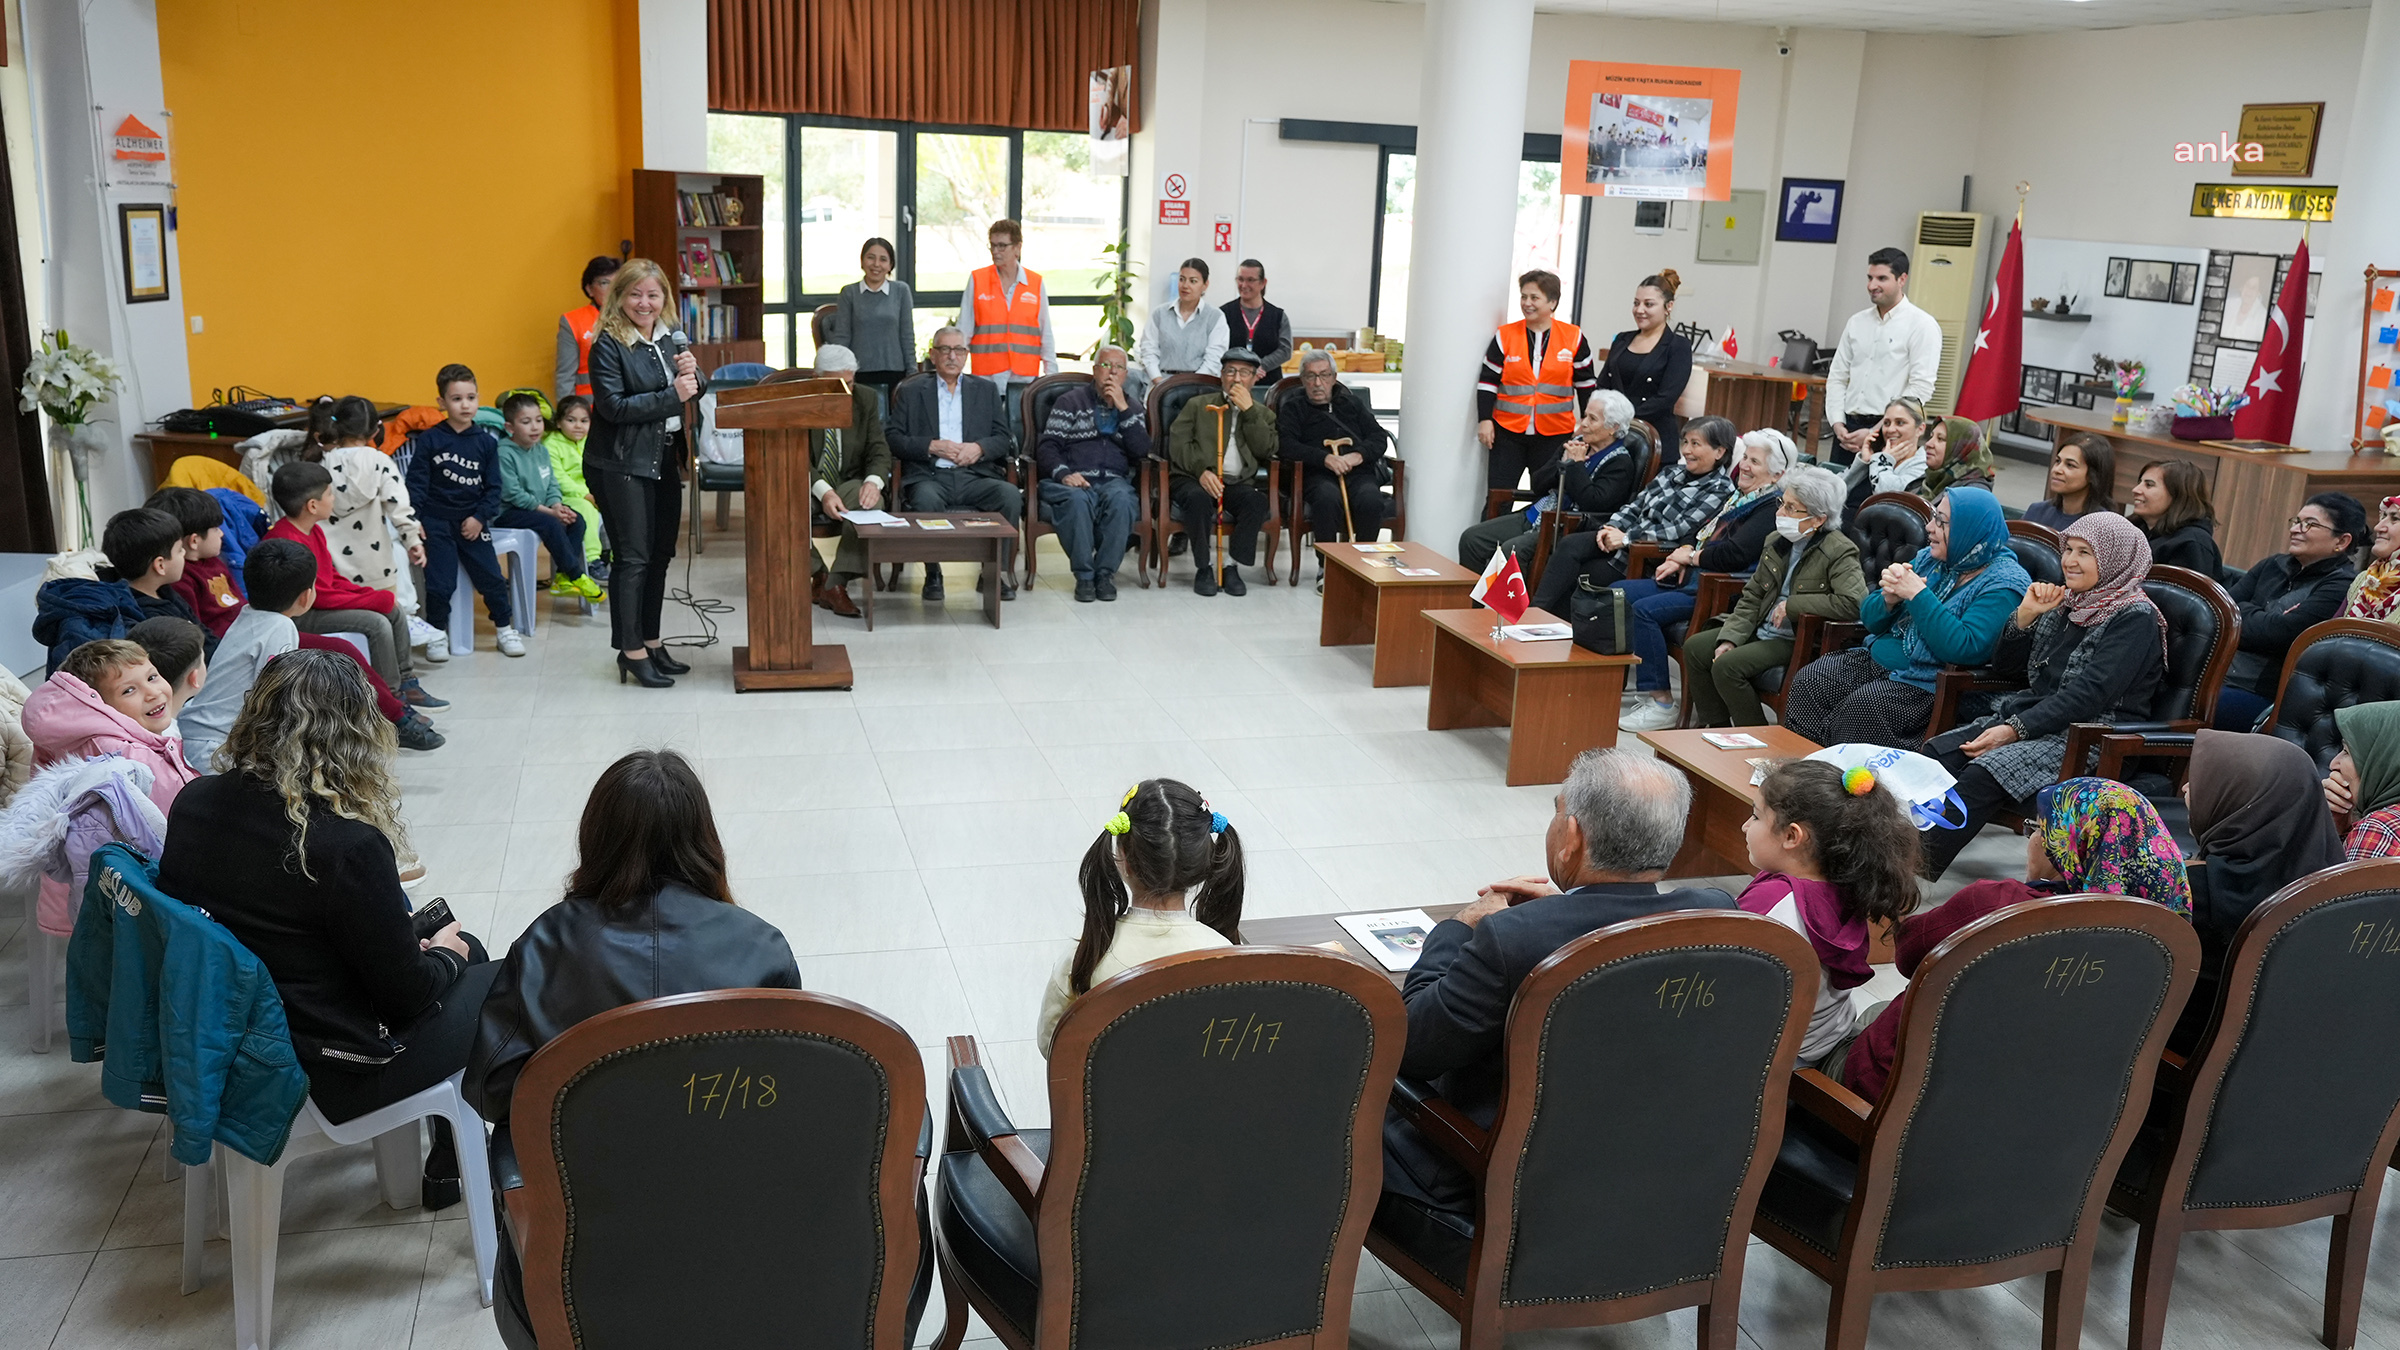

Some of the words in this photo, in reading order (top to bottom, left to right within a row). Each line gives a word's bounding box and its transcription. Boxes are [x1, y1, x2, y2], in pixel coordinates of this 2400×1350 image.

[115, 137, 164, 150] ALZHEIMER
[2245, 192, 2285, 210] AYDIN
[433, 452, 480, 471] REALLY
[1654, 971, 1717, 1018] 17/16
[2043, 951, 2106, 997] 17/15
[1202, 1011, 1283, 1061] 17/17
[682, 1066, 778, 1120] 17/18
